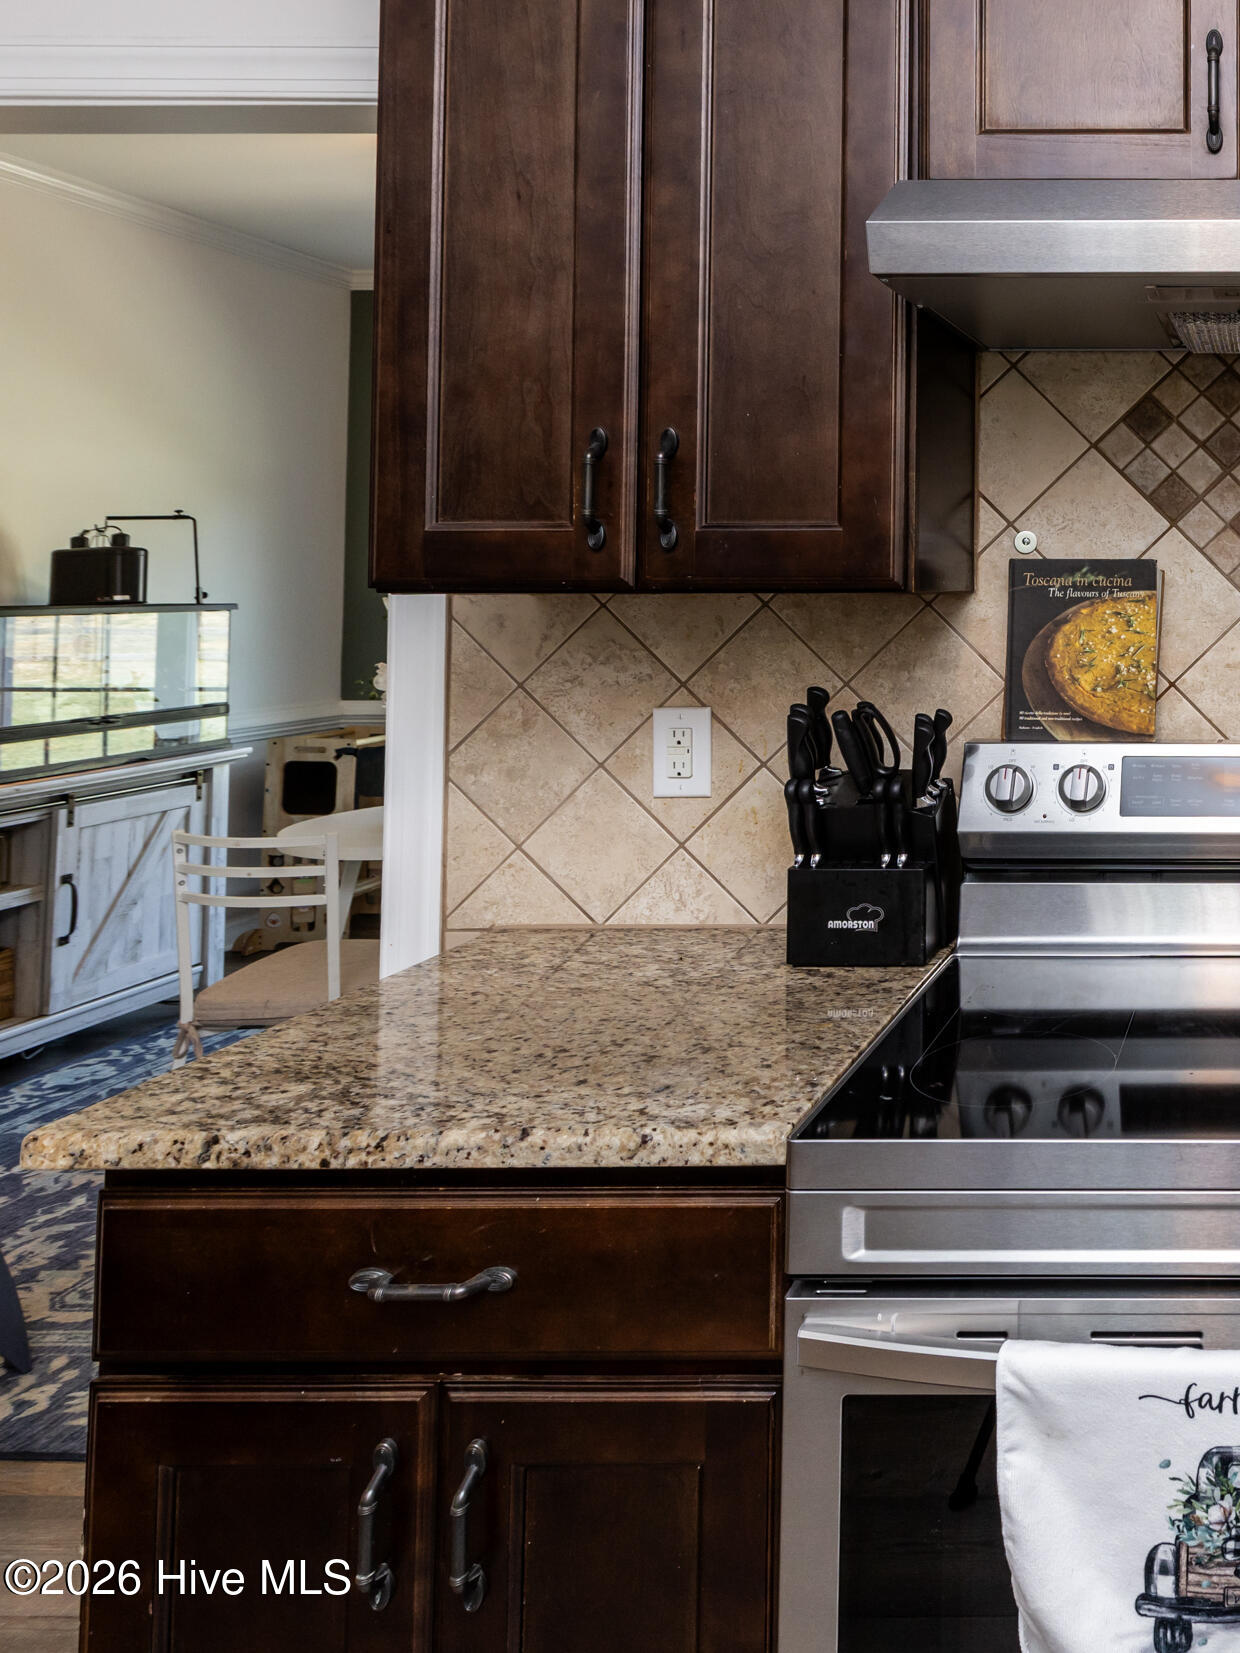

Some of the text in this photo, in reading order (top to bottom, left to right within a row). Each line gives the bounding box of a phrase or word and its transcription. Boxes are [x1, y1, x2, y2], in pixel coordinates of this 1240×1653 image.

[1023, 572, 1133, 588] Toscana in cucina
[1048, 587, 1145, 599] The flavours of Tuscany
[827, 920, 875, 929] AMORSTON
